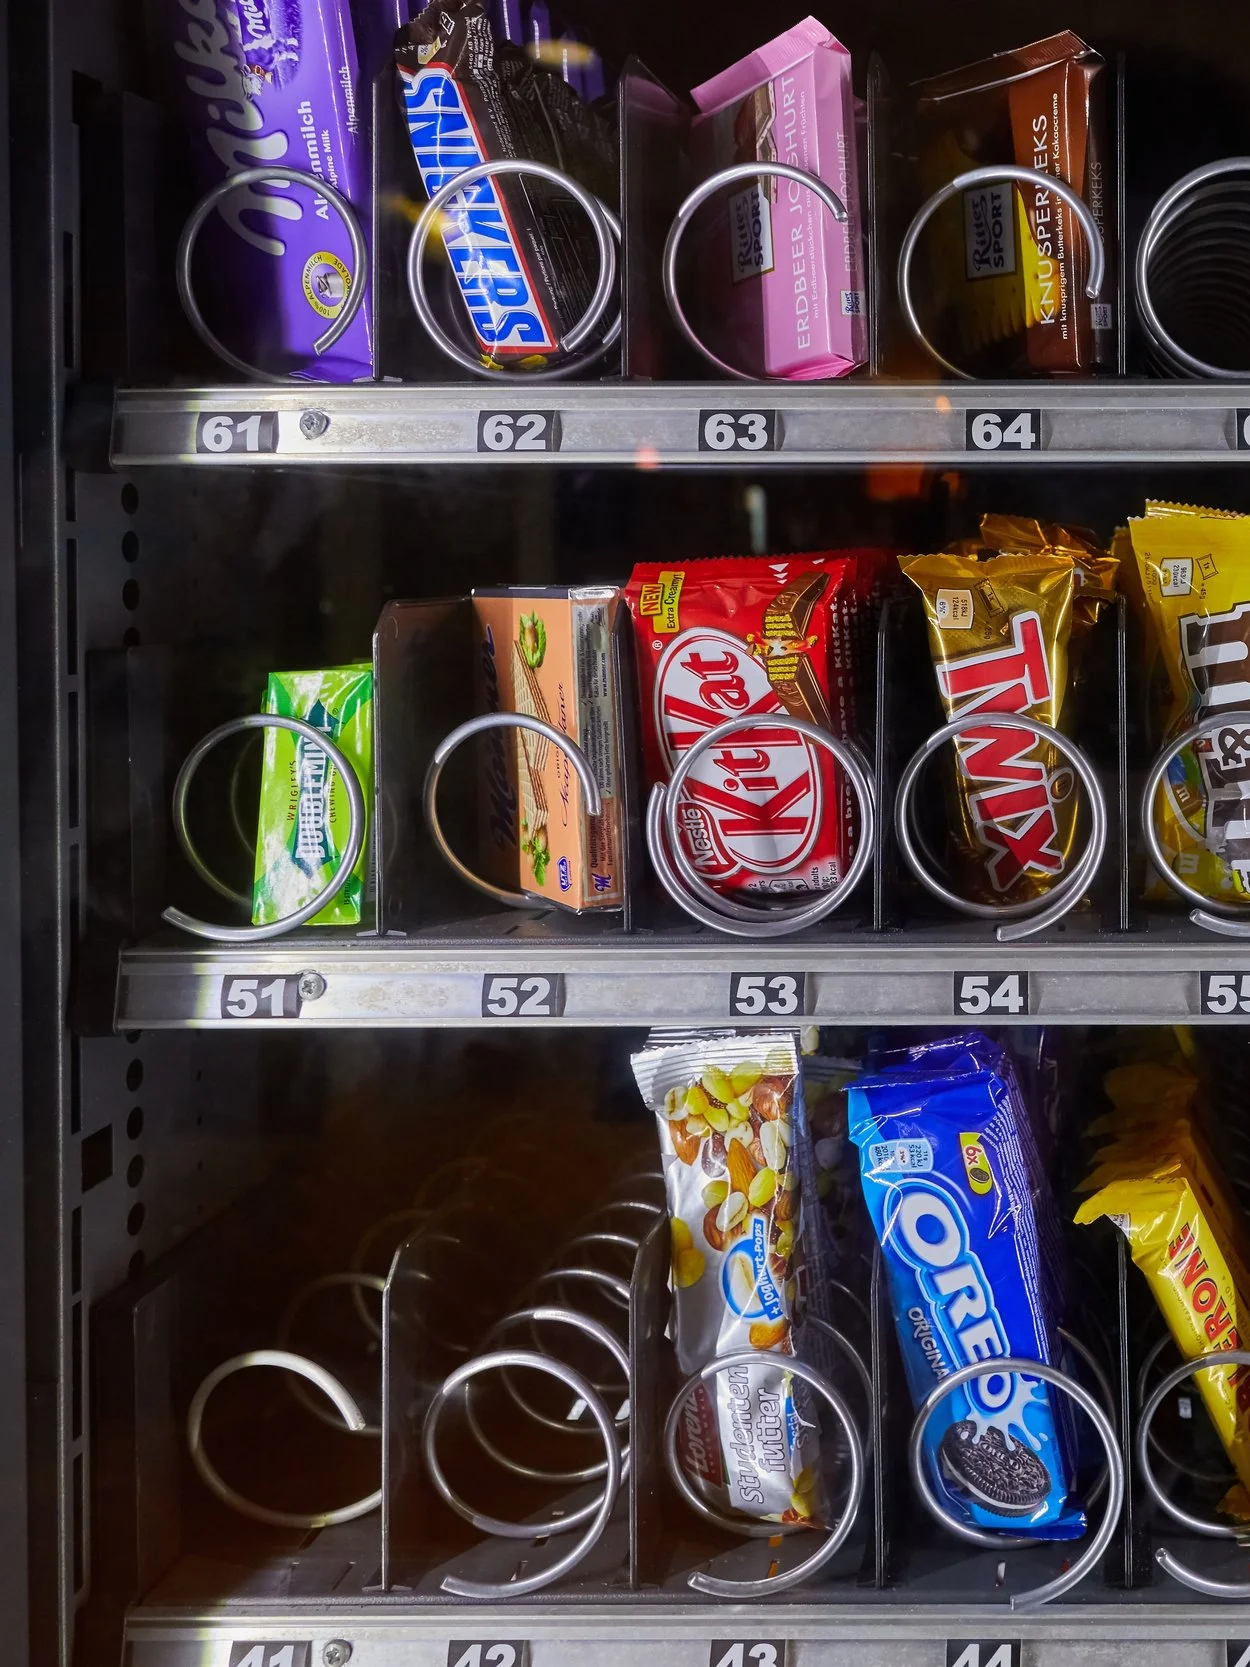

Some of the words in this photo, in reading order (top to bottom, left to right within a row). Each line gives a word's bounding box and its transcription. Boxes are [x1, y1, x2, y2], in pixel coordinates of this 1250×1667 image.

[339, 66, 360, 135] Alpenmilch
[798, 91, 808, 135] Früchten
[321, 129, 332, 153] Milk
[1051, 92, 1060, 160] Kakaocreme
[752, 191, 764, 267] SPORT
[991, 191, 1004, 268] SPORT
[1055, 207, 1064, 260] Butterkeks
[806, 211, 819, 301] Erdbeerstückchen
[304, 254, 322, 301] ALPENMILCH
[789, 226, 811, 351] ERDBEER
[1058, 262, 1068, 322] knusprigem
[812, 304, 820, 319] mit
[1060, 325, 1068, 340] mit
[200, 416, 262, 451] 61
[482, 414, 548, 450] 62
[703, 414, 768, 450] 63
[968, 413, 1034, 449] 64
[643, 585, 661, 613] NEW
[667, 607, 676, 629] Extra
[952, 596, 960, 621] 124kcal
[836, 677, 844, 688] a
[287, 760, 298, 821] WRIGLEY'S
[829, 861, 837, 876] kcal
[226, 979, 290, 1018] 51
[485, 978, 552, 1017] 52
[734, 976, 800, 1016] 53
[957, 976, 1024, 1015] 54
[908, 1143, 916, 1154] 53
[909, 1154, 917, 1168] kcal
[914, 1144, 922, 1158] 220
[916, 1159, 923, 1167] kJ
[964, 1144, 982, 1166] 6x
[754, 1222, 778, 1306] Joghurt-Pops
[898, 1193, 1017, 1411] OREO
[908, 1306, 950, 1384] ORIGINA
[728, 1364, 764, 1505] Studenten
[757, 1387, 788, 1473] futter
